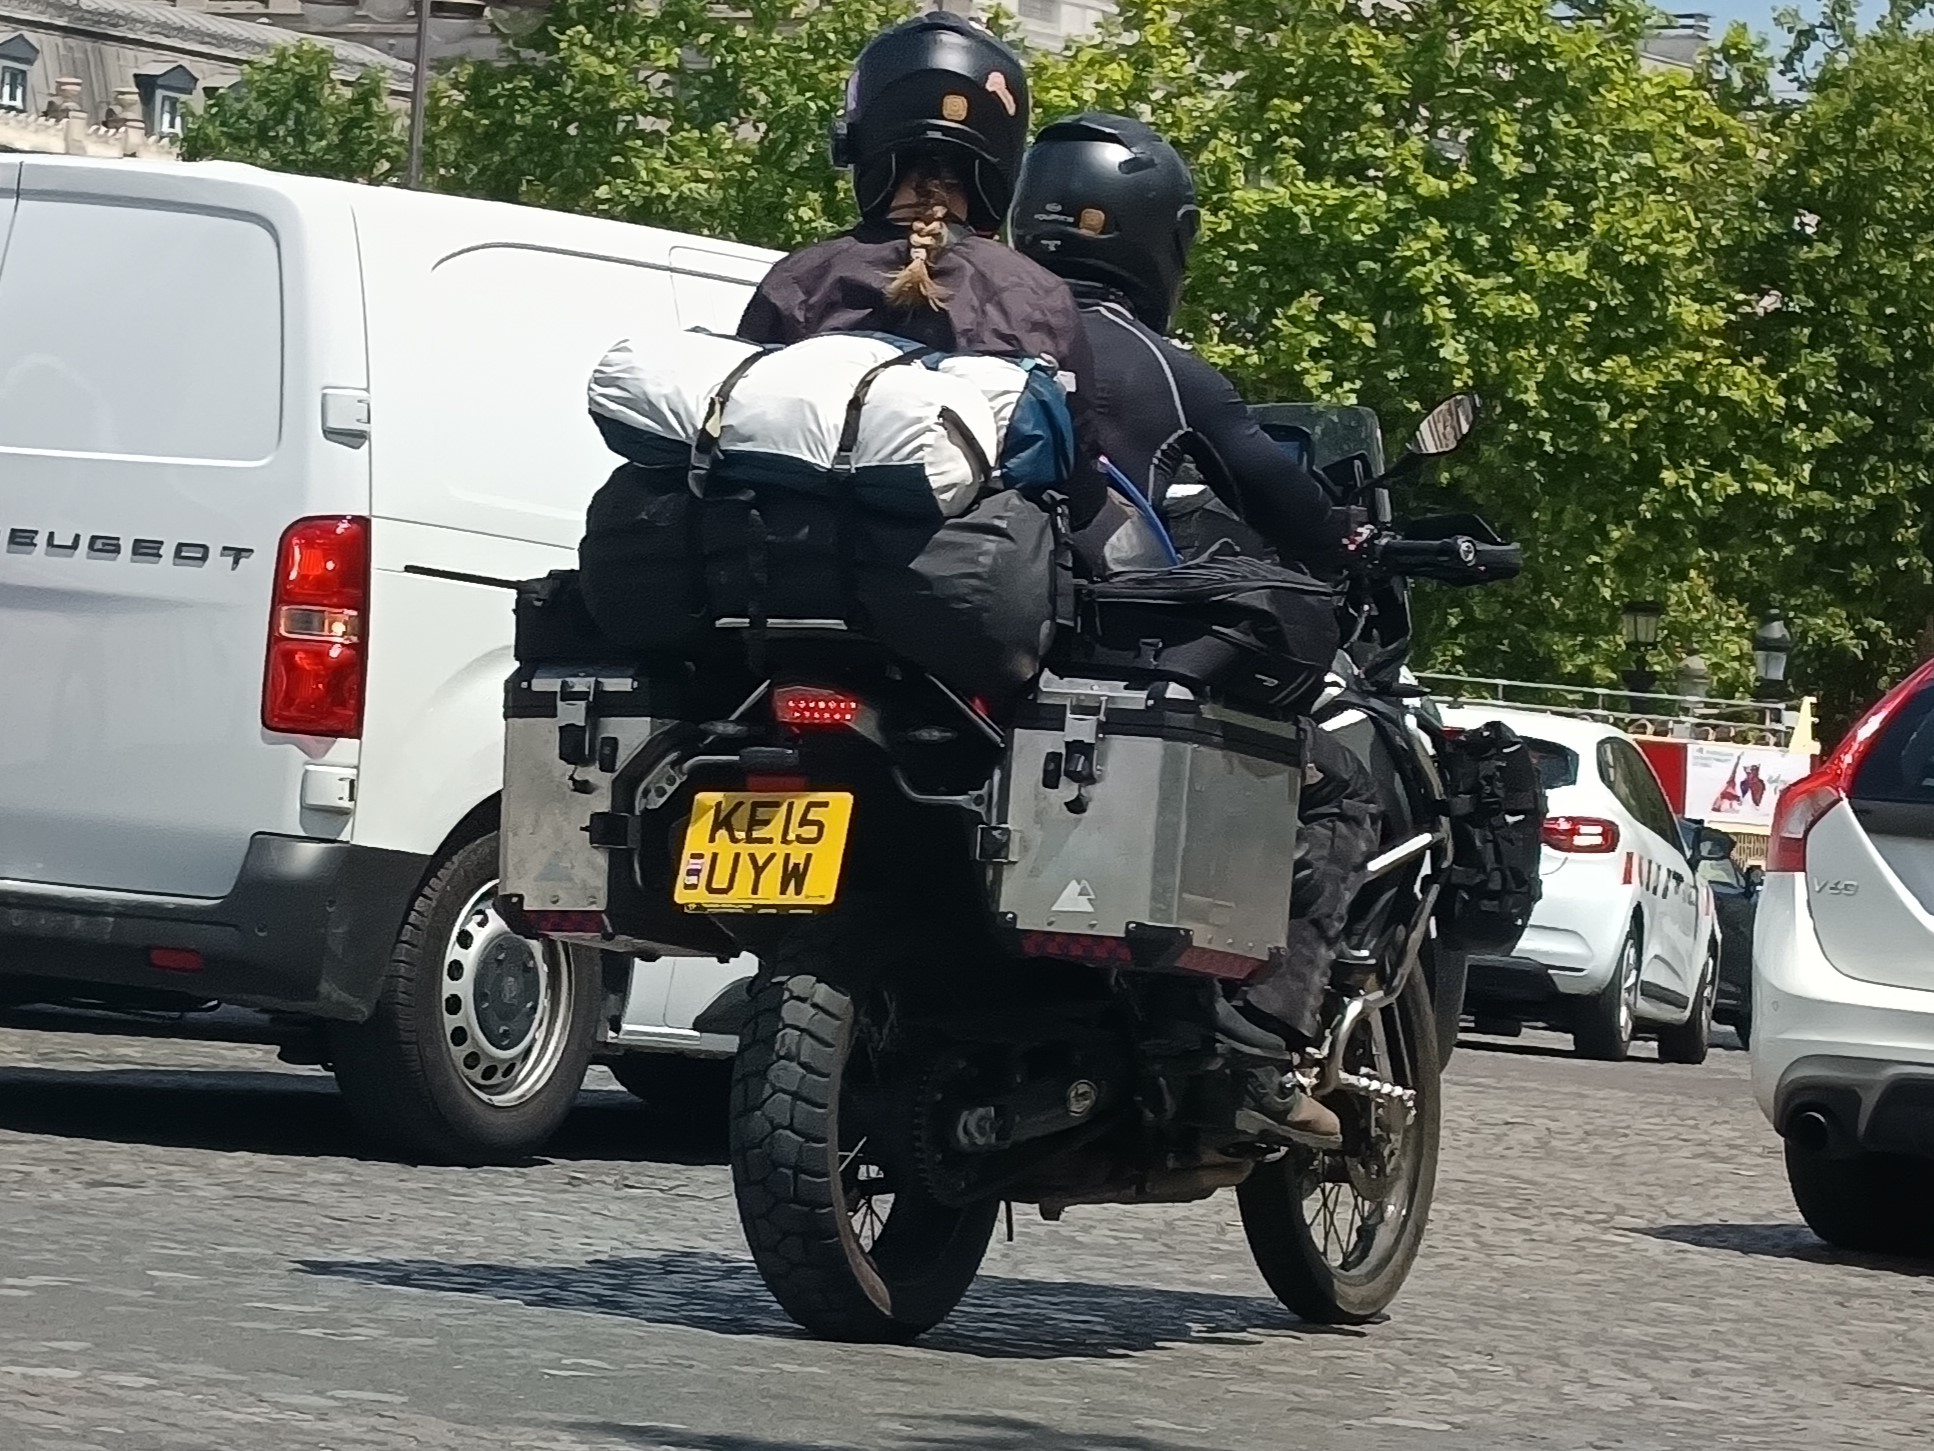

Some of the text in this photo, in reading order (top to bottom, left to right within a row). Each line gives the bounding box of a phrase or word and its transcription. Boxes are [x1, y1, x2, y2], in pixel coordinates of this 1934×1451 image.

[0, 528, 255, 571] EUGEOT
[708, 800, 830, 845] KE15
[704, 851, 813, 896] UYW
